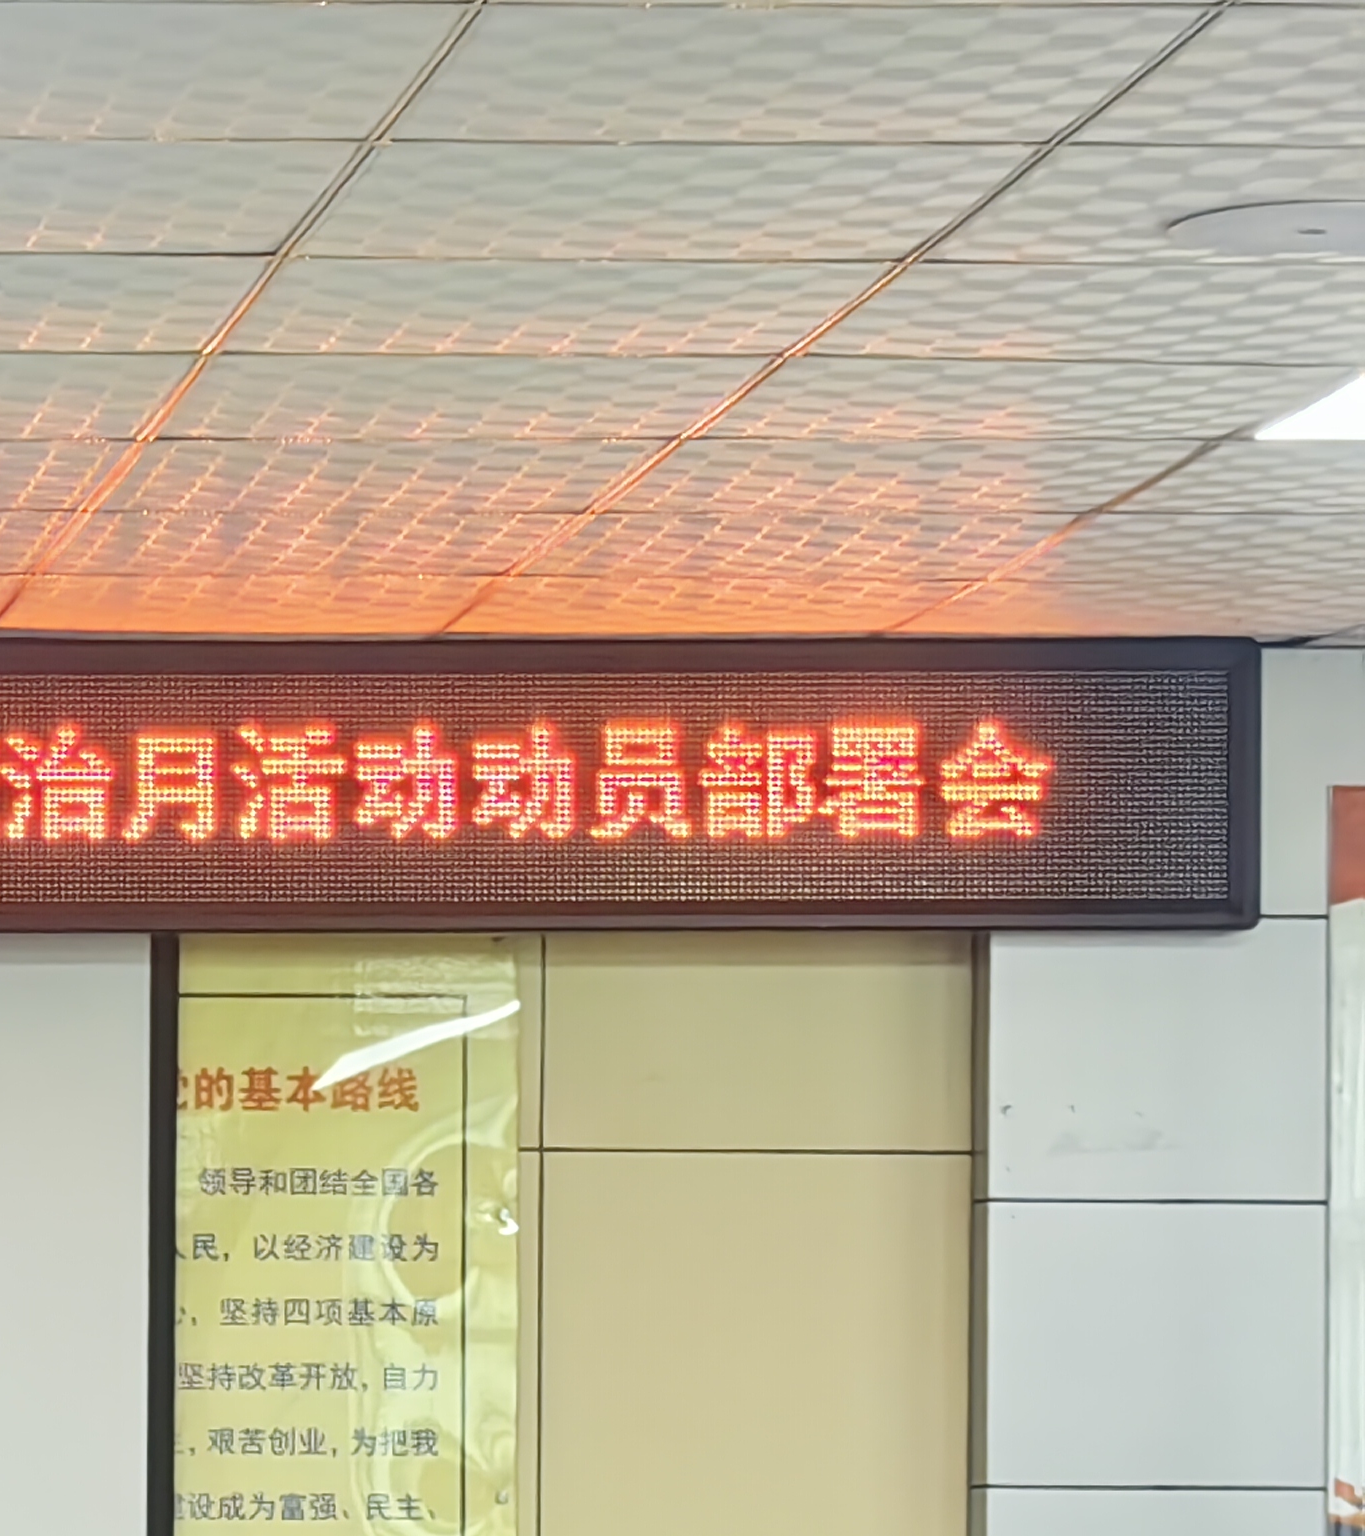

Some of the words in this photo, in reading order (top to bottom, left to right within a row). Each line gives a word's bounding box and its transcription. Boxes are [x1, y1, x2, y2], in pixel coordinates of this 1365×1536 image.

[176, 1066, 420, 1113] 的基本路线
[199, 1168, 440, 1197] 领导和团结全国各
[177, 1298, 439, 1327] ，坚持四项基本原
[175, 1427, 440, 1457] ，艰苦创业，为把我
